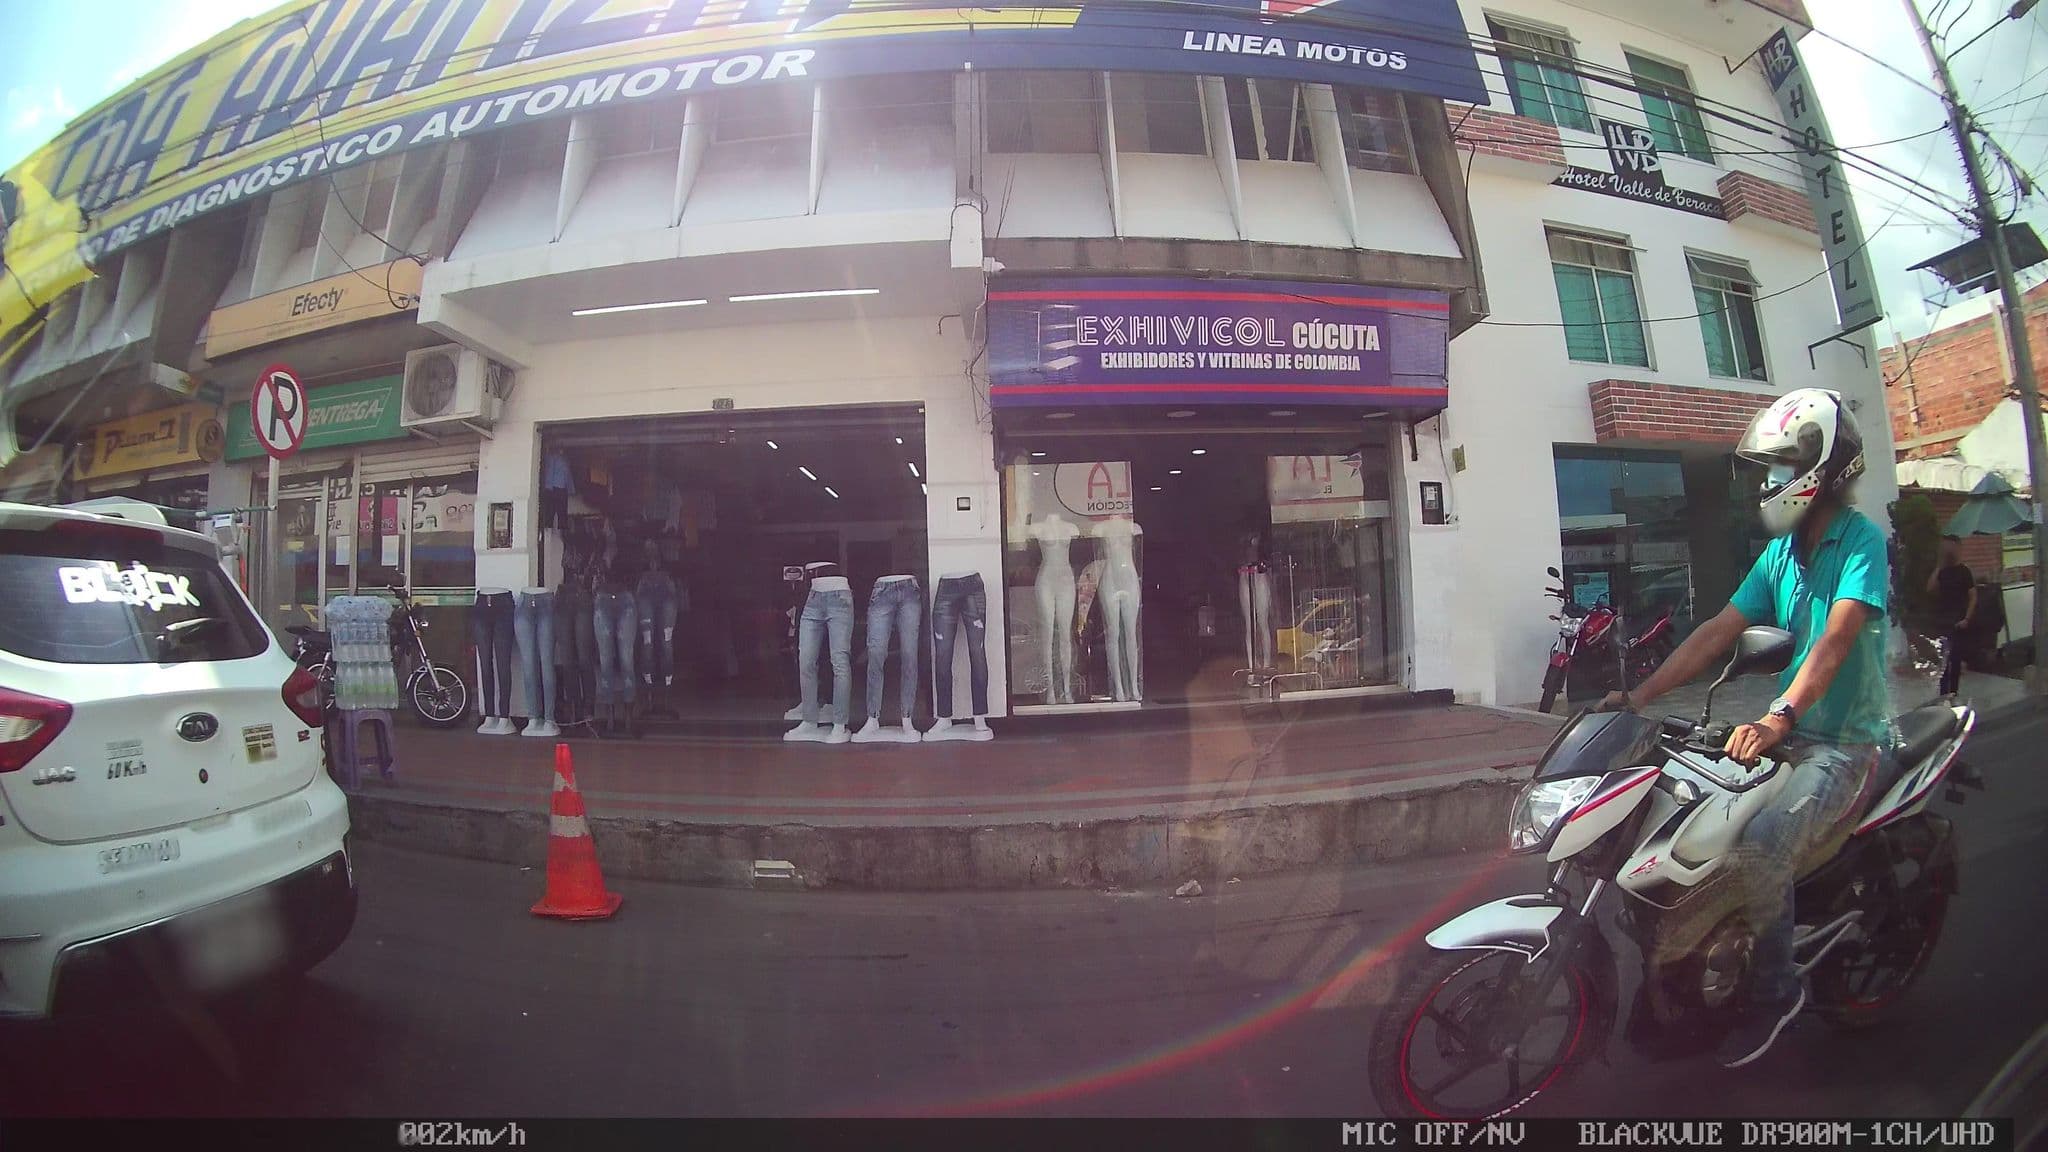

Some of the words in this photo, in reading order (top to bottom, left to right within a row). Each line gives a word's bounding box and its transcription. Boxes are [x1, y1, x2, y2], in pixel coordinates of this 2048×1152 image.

[1183, 30, 1286, 57] LINEA
[1297, 41, 1408, 70] MOTOS
[104, 215, 146, 252] DE
[409, 48, 816, 144] AUTOMOTOR
[1560, 167, 1606, 189] Hotel
[1608, 175, 1652, 199] Valle
[1655, 185, 1672, 203] de
[1789, 83, 1857, 291] HOTEL
[291, 287, 344, 317] Efecty
[1076, 315, 1286, 347] EXHIVICOL
[1292, 318, 1381, 351] CÚCUTA
[1101, 351, 1193, 369] EXHIBIDORES
[1197, 353, 1207, 369] Y
[1209, 353, 1273, 369] VITRINAS
[1275, 354, 1292, 370] DE
[1294, 354, 1361, 372] COLOMBIA
